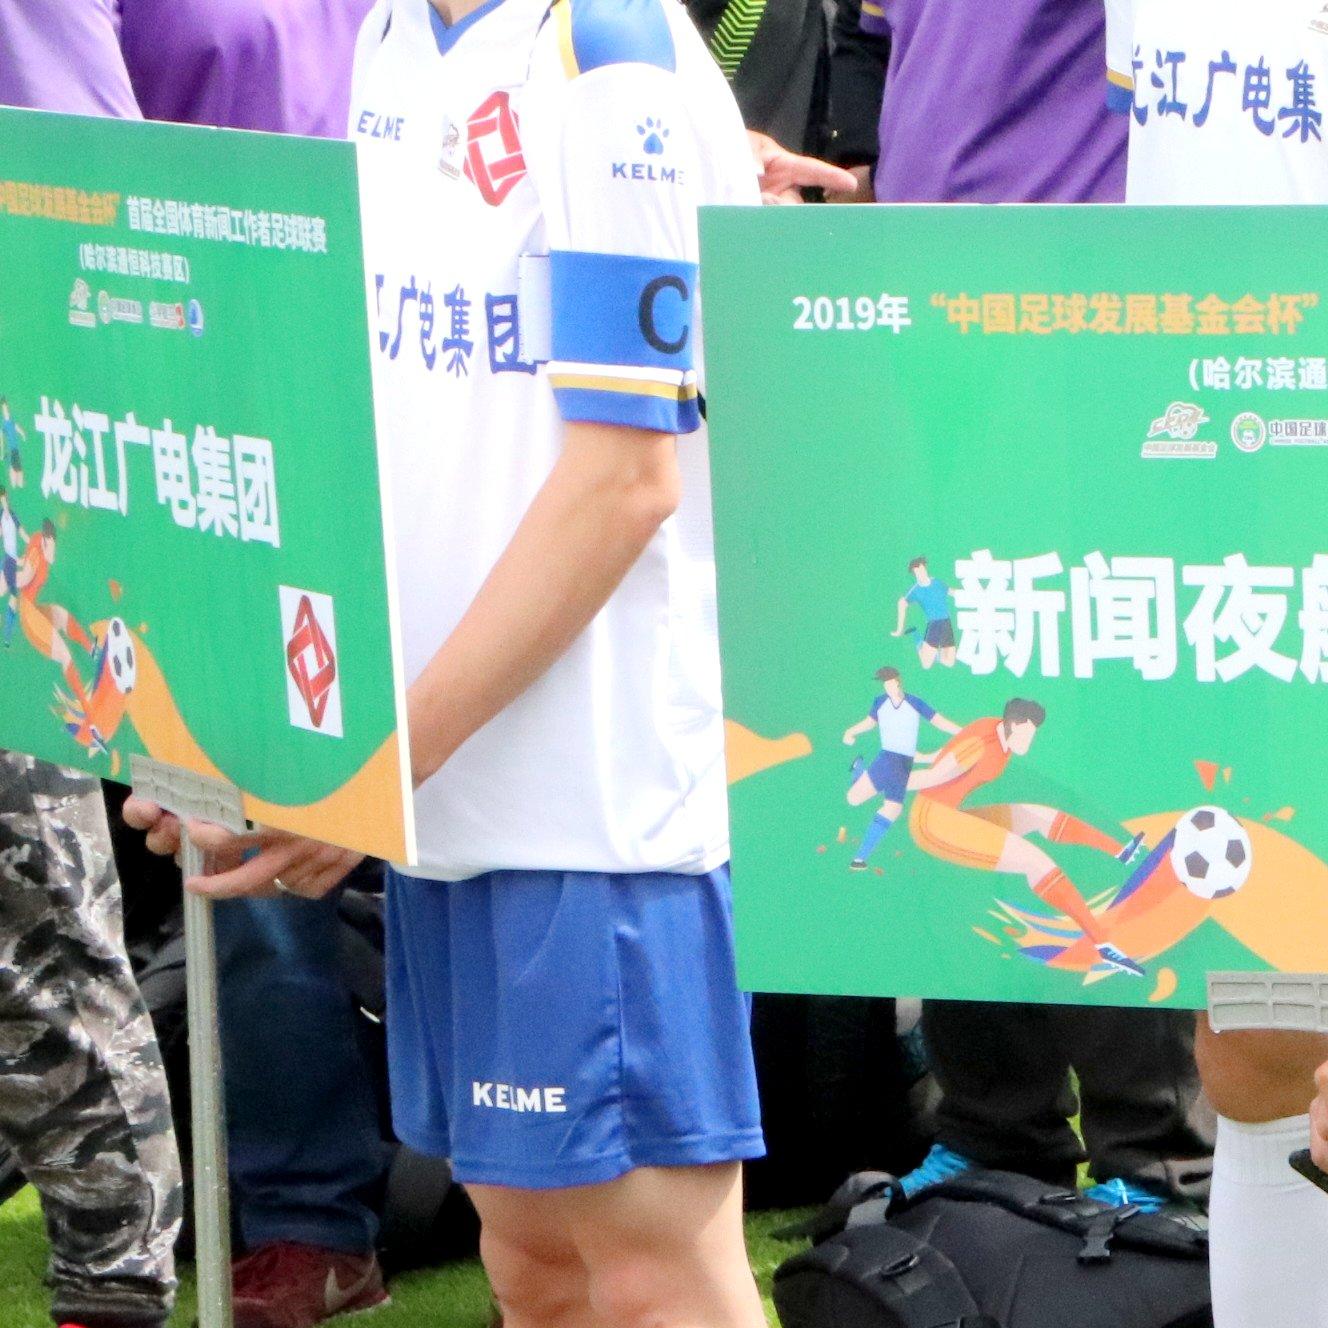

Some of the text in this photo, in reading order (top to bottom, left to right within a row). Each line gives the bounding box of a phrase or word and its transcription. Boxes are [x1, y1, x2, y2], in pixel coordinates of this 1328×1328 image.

[611, 161, 686, 186] KELME
[638, 275, 689, 355] C
[792, 294, 912, 334] 2019年
[929, 292, 1320, 336] “中国足球发展基金会杯”
[34, 395, 281, 549] 龙江广电集团
[472, 1081, 567, 1113] KELME
